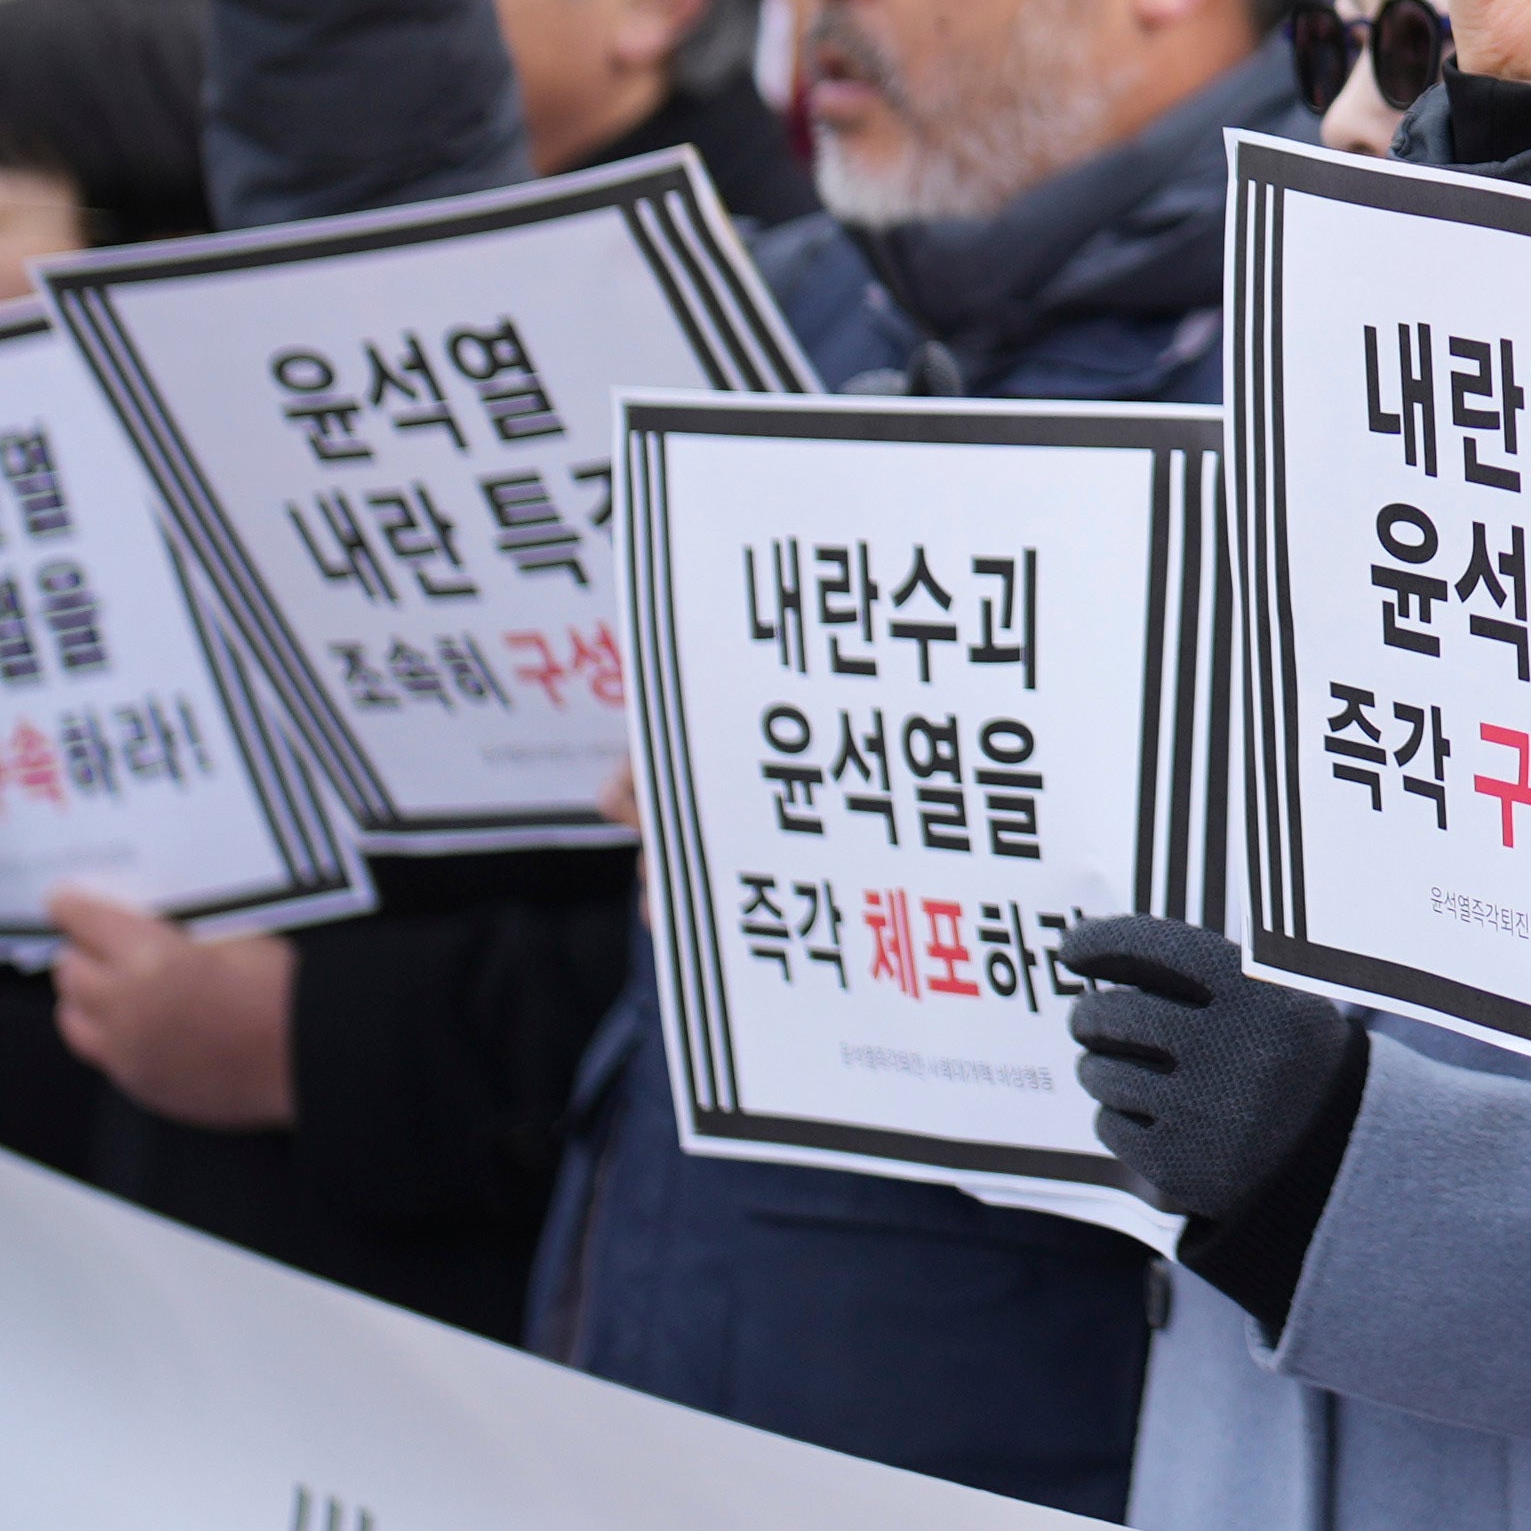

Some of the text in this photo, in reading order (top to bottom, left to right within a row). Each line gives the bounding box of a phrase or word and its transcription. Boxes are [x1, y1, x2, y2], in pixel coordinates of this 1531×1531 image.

[271, 316, 567, 461] 윤석열
[286, 482, 478, 602] 내란
[506, 622, 628, 708] 구성
[743, 535, 1040, 690] 내란수괴
[0, 693, 212, 815] 속하라!
[760, 704, 1044, 862] 윤석열을
[1323, 681, 1451, 832] 즉각
[738, 873, 849, 991] 즉각
